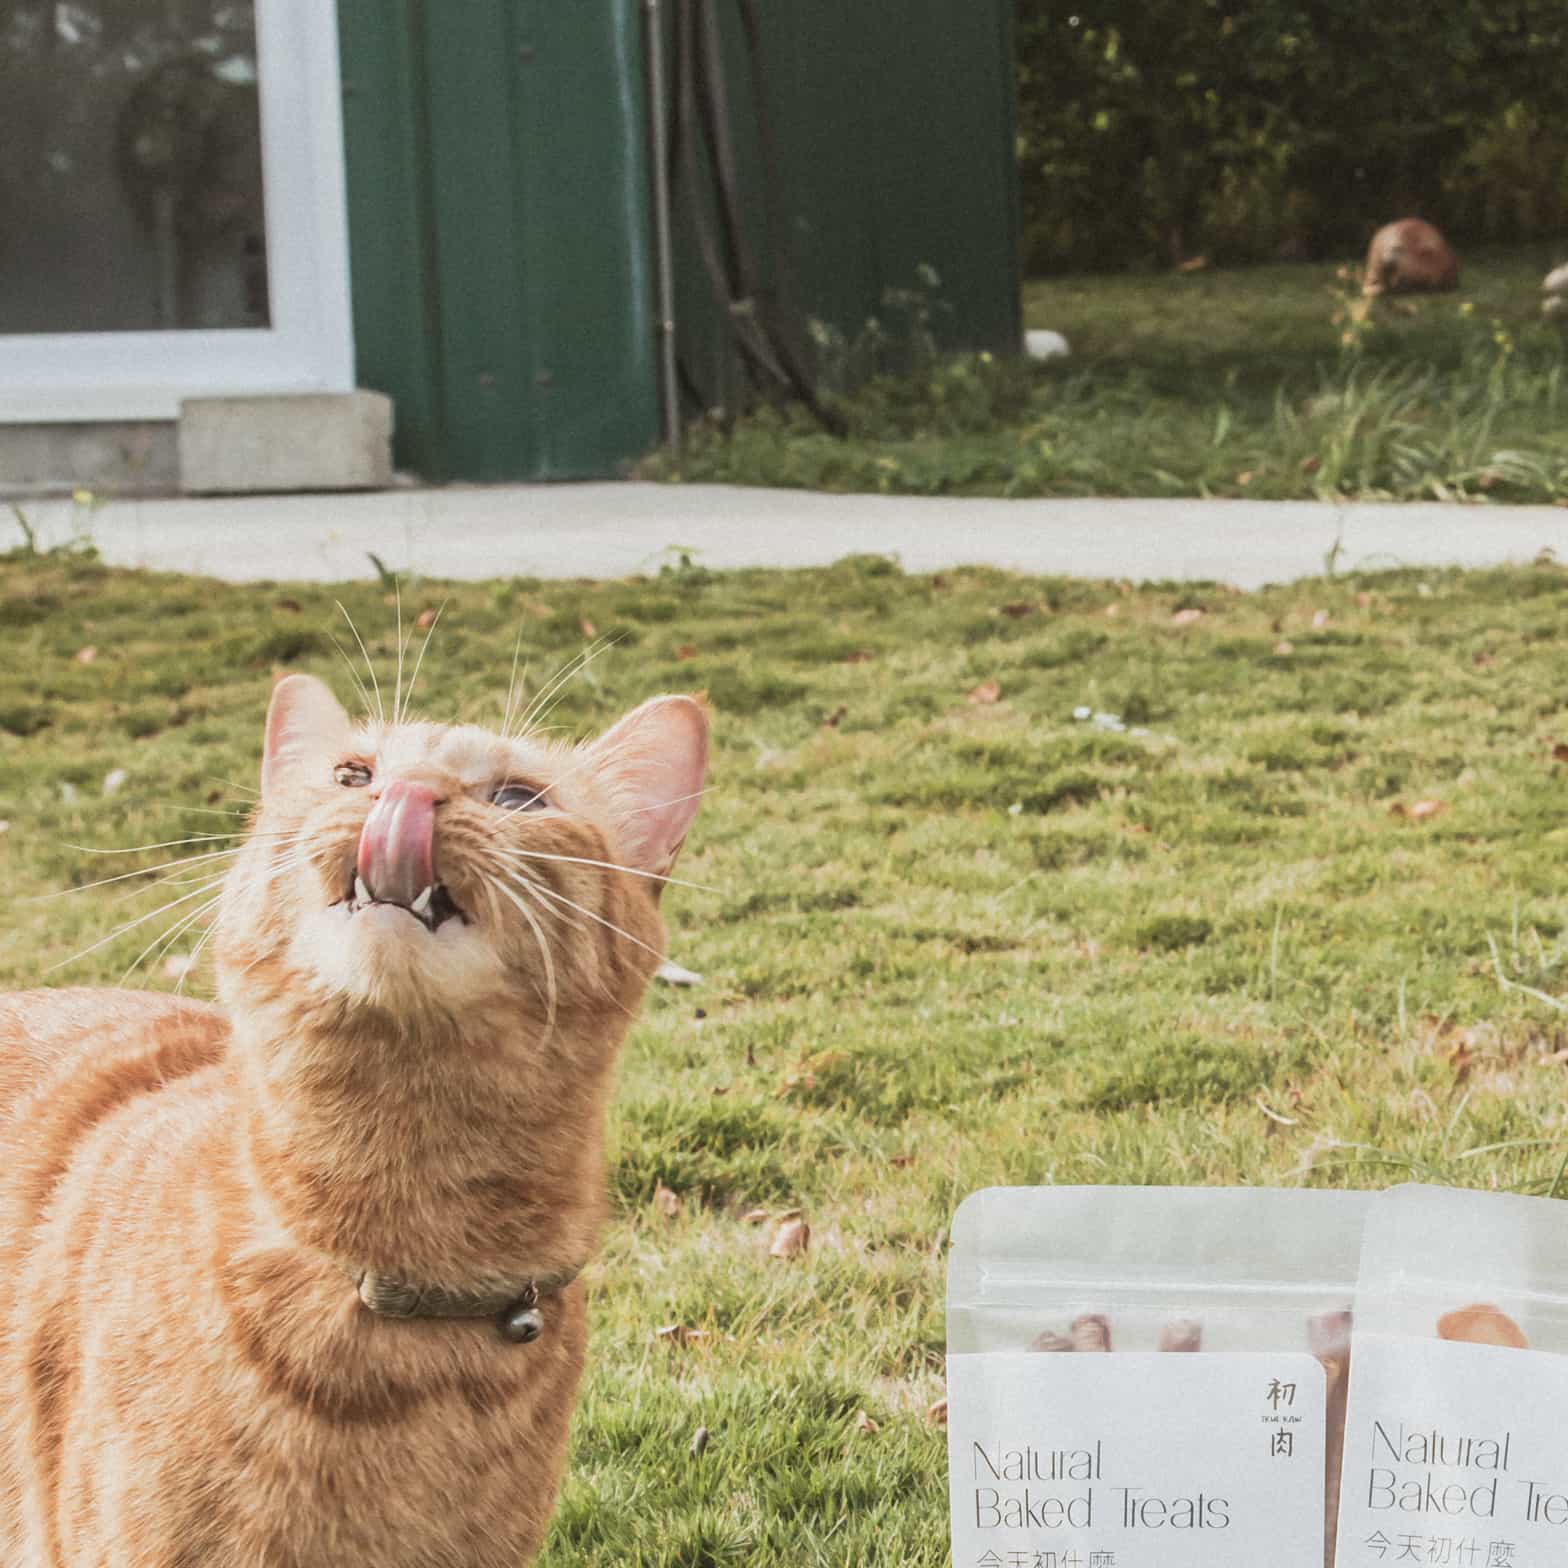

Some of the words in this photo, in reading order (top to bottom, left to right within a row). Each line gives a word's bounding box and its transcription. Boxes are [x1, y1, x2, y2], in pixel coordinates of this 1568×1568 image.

[1266, 1377, 1297, 1411] 初
[973, 1439, 1102, 1481] Natural
[1271, 1426, 1294, 1457] 肉
[1371, 1420, 1510, 1471] Natural
[975, 1487, 1092, 1529] Baked
[1110, 1487, 1232, 1529] Treats
[1367, 1467, 1498, 1517] Baked
[1363, 1530, 1517, 1568] 今天初什麼
